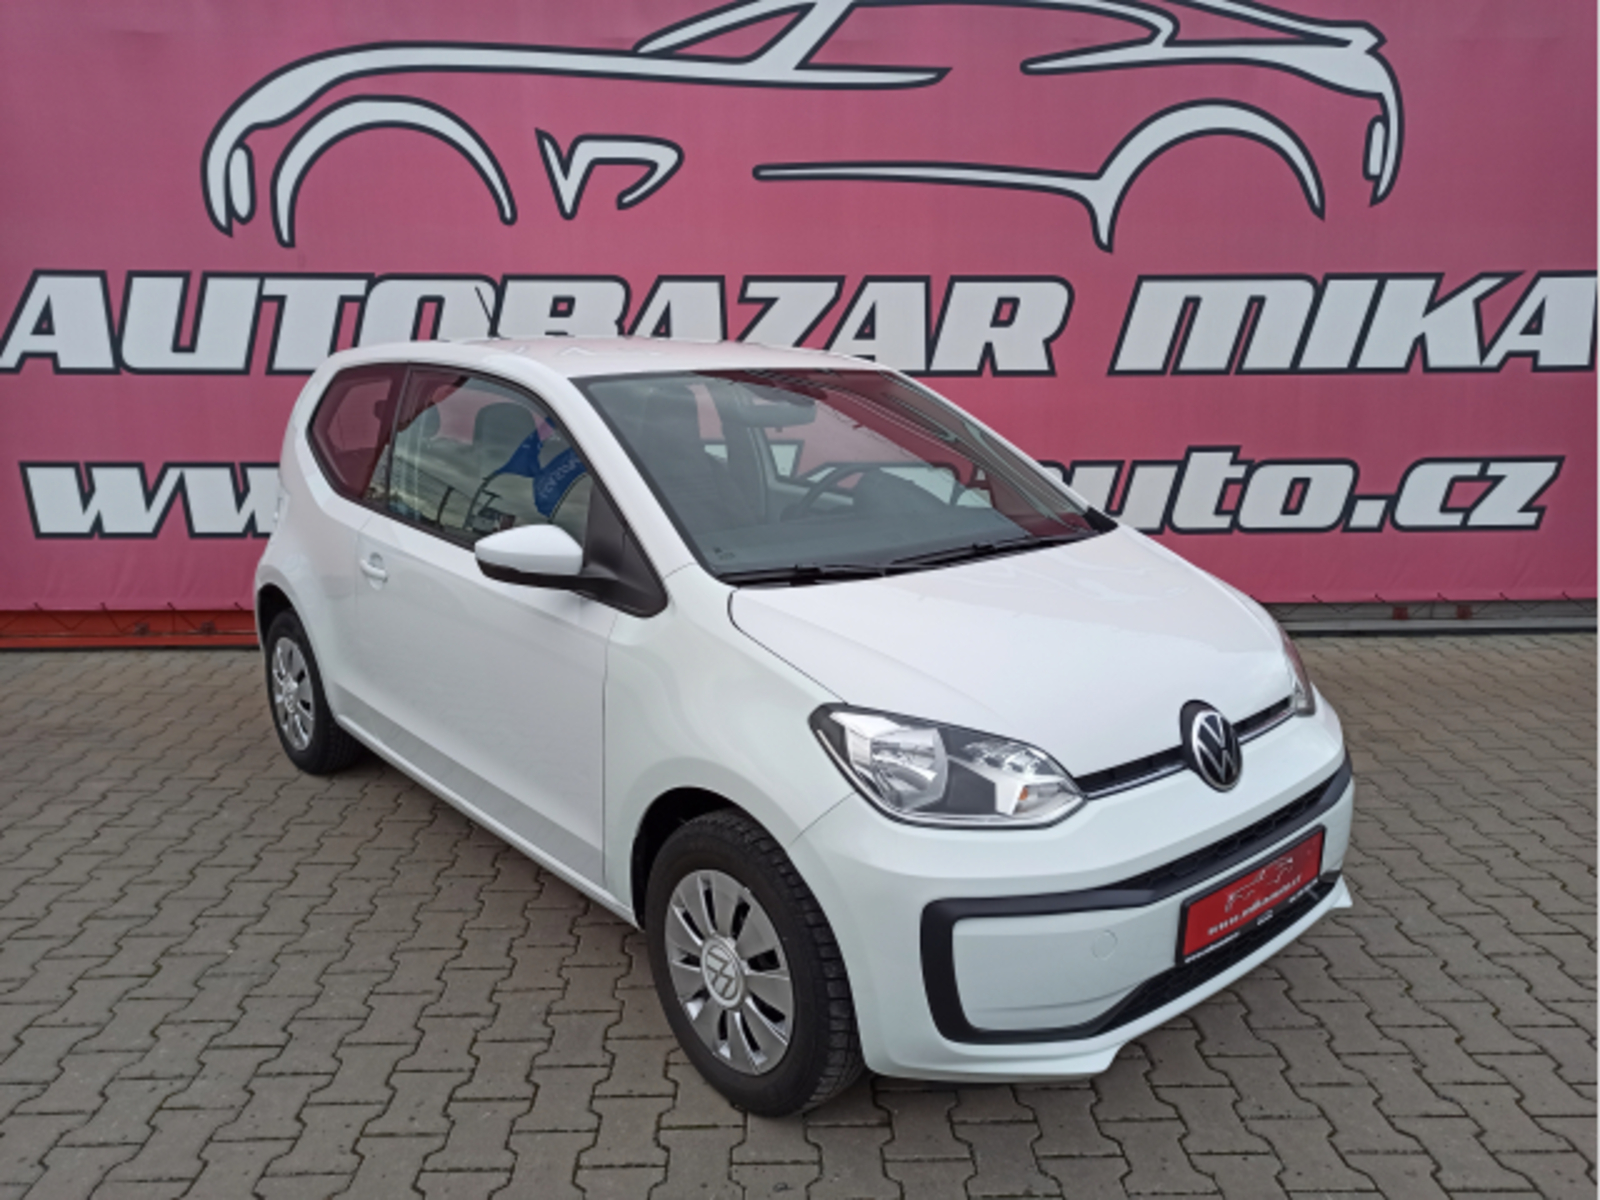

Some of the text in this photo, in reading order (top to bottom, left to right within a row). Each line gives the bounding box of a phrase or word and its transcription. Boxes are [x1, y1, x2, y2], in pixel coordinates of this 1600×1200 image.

[0, 270, 1597, 377] AUTOBAZAR MIKA
[1036, 445, 1564, 535] uto.cz
